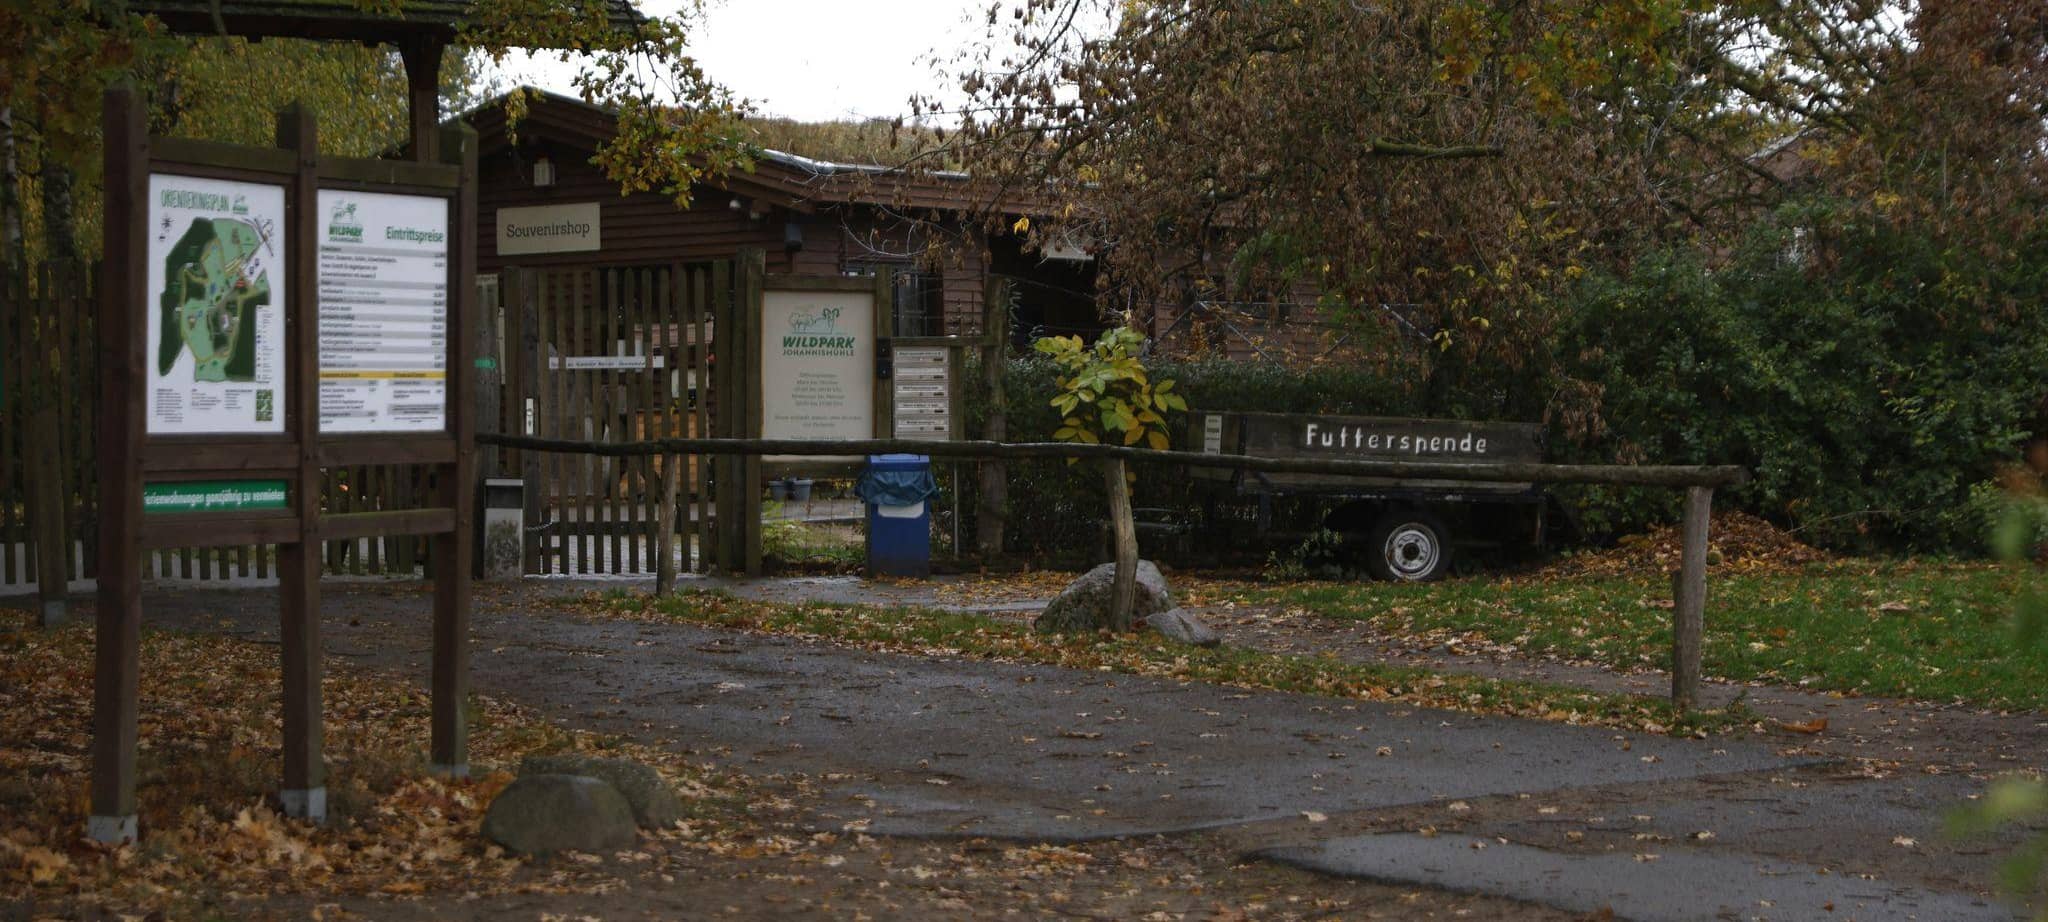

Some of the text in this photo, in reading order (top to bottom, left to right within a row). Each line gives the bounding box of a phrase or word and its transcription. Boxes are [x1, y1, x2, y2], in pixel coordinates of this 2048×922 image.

[386, 226, 444, 244] Eintrittspreise
[506, 219, 591, 238] Souvenirshop
[782, 335, 856, 349] WILDPARK
[1306, 423, 1488, 454] Futterspende
